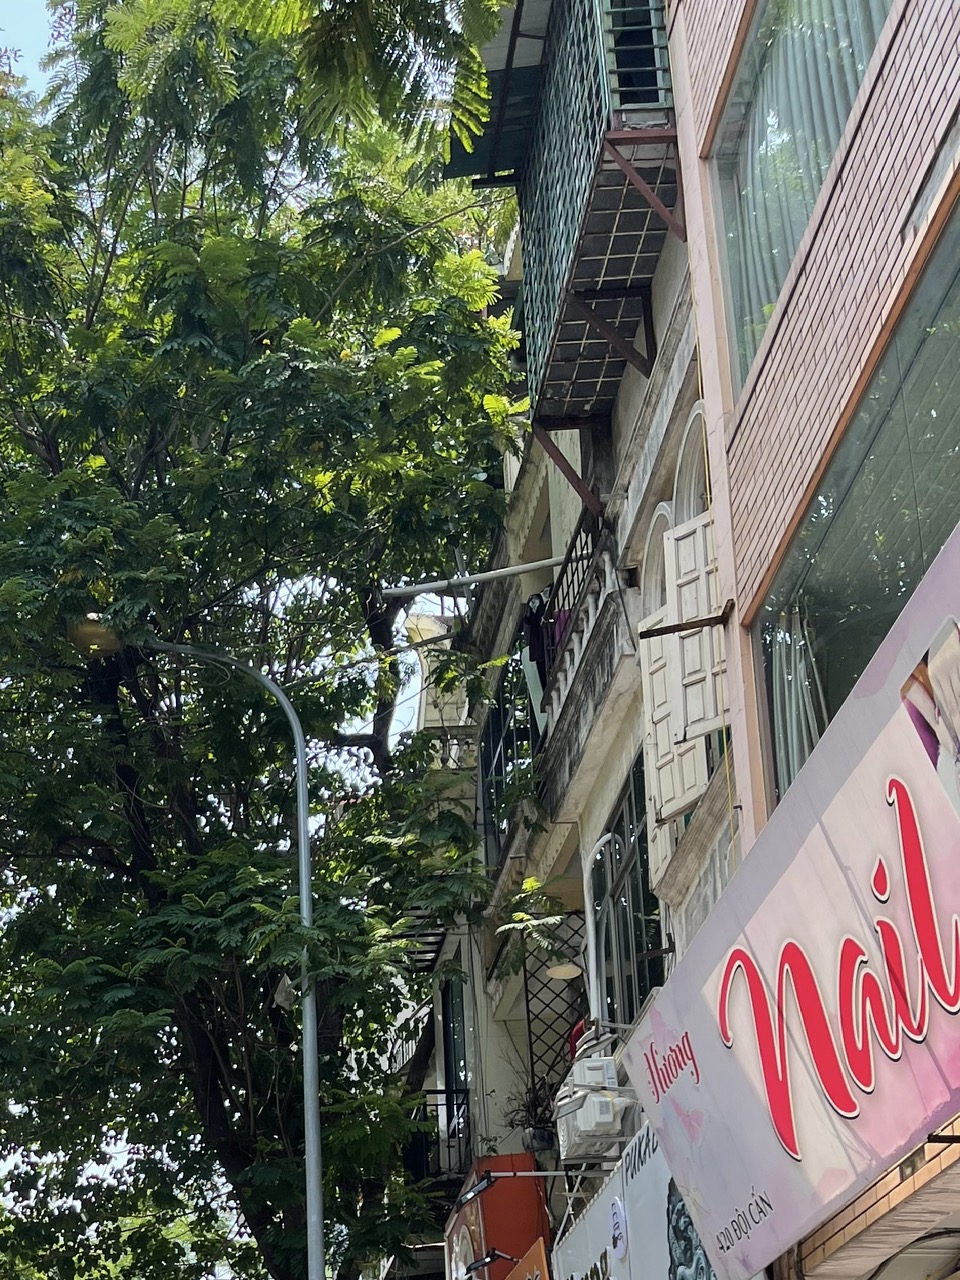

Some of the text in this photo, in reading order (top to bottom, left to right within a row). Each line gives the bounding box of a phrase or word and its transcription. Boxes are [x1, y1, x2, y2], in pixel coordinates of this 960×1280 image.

[716, 1185, 773, 1253] 420 ĐỘI CẤN
